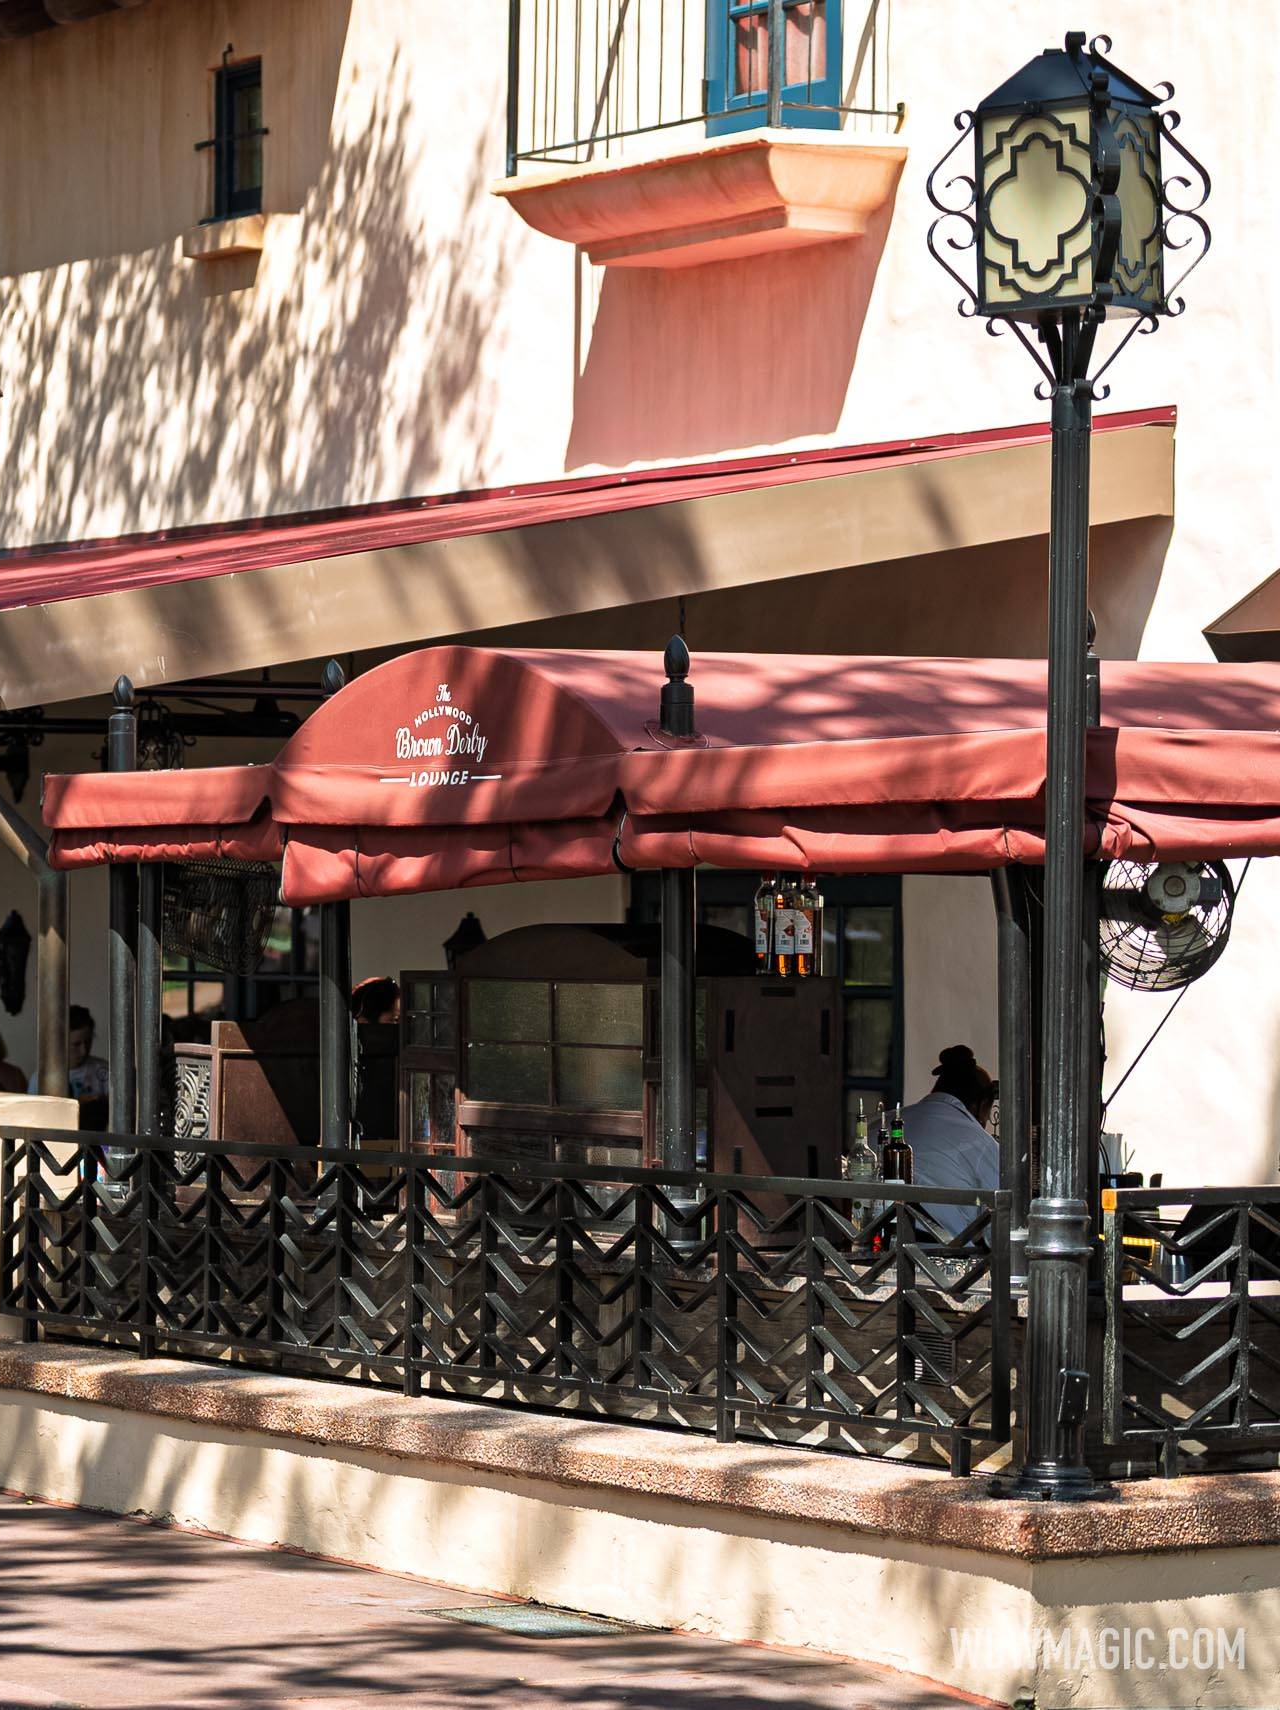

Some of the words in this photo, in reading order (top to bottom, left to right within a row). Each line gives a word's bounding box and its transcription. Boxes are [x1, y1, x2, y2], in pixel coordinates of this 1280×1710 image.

[436, 683, 451, 702] The
[414, 705, 473, 728] HOLLYWOOD
[395, 727, 443, 759] Brown
[445, 723, 488, 763] Derby
[409, 771, 469, 787] LOUNGE
